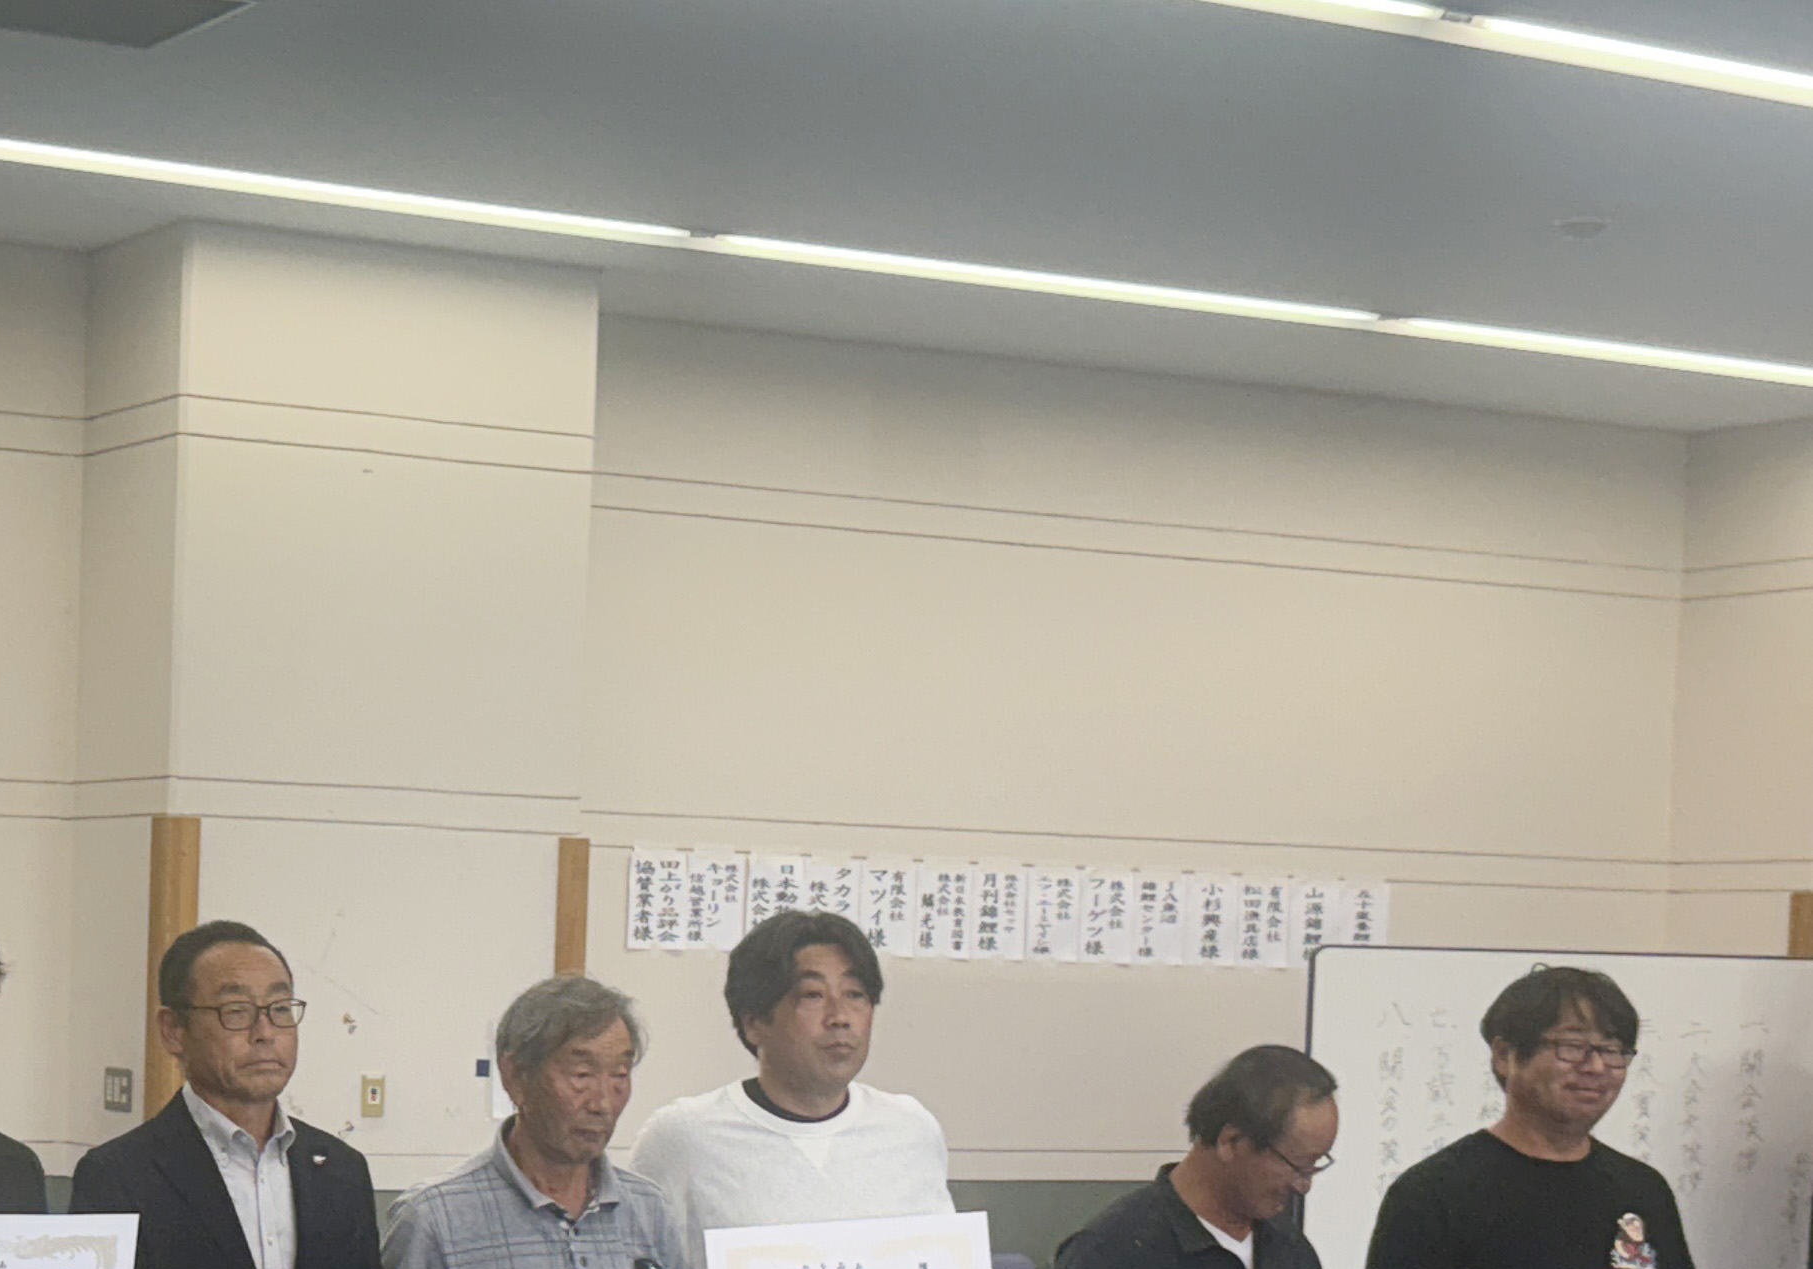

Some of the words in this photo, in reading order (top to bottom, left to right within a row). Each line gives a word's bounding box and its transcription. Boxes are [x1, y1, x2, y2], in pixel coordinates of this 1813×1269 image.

[634, 860, 655, 942] 協賛業者様
[657, 861, 682, 942] 田上がり品評会
[889, 871, 906, 921] 有限会社
